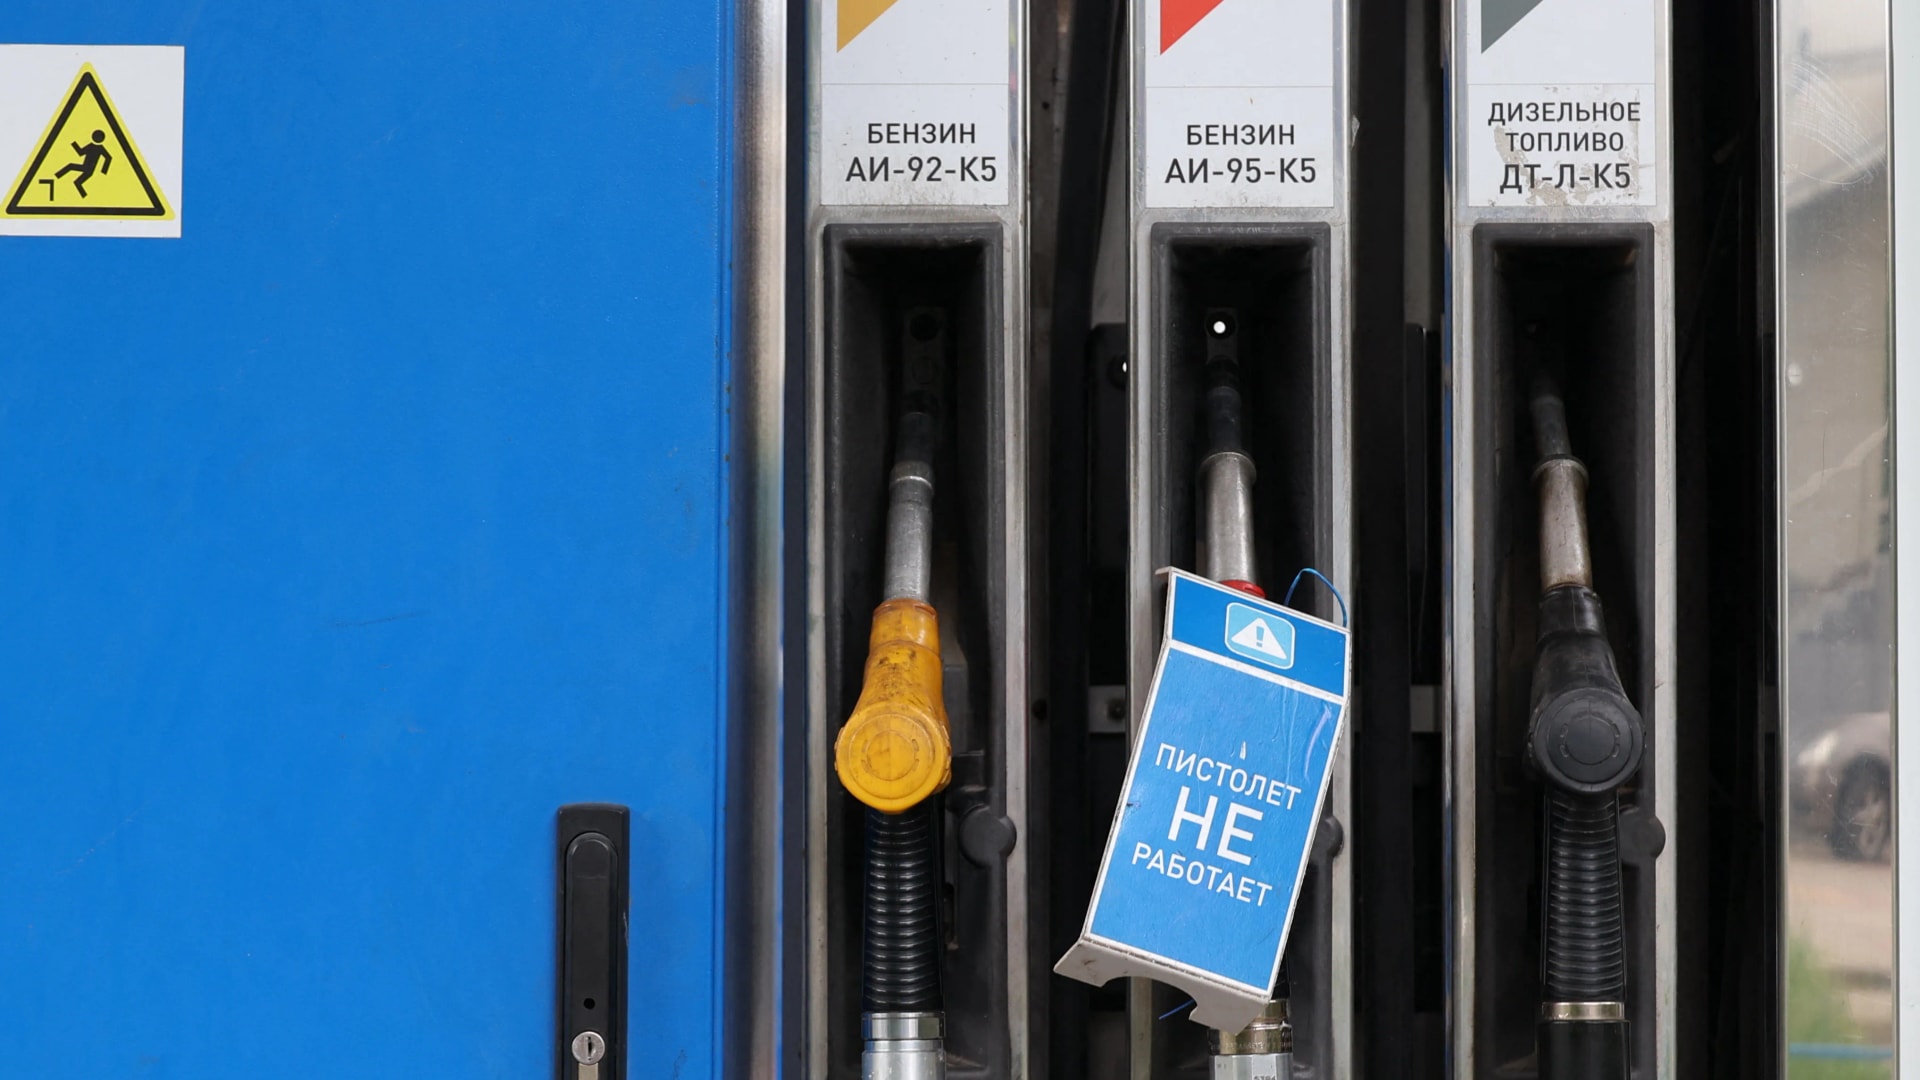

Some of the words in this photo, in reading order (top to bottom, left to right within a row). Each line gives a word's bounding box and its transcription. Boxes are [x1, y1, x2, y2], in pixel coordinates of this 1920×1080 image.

[1488, 102, 1641, 126] ДИЗЕЛЬНОЕ
[868, 123, 976, 145] БЕНЗИН
[1186, 124, 1296, 146] БЕНЗИН
[1505, 132, 1624, 152] ТОПЛИВО
[846, 156, 998, 183] АИ-92-К5
[1165, 158, 1317, 185] АИ-95-К5
[1500, 163, 1631, 194] ДТ-Л-К5
[1155, 743, 1302, 810] ПИСТОЛЕТ
[1167, 785, 1264, 866] НЕ
[1131, 842, 1272, 907] РАБОТАЕТ
